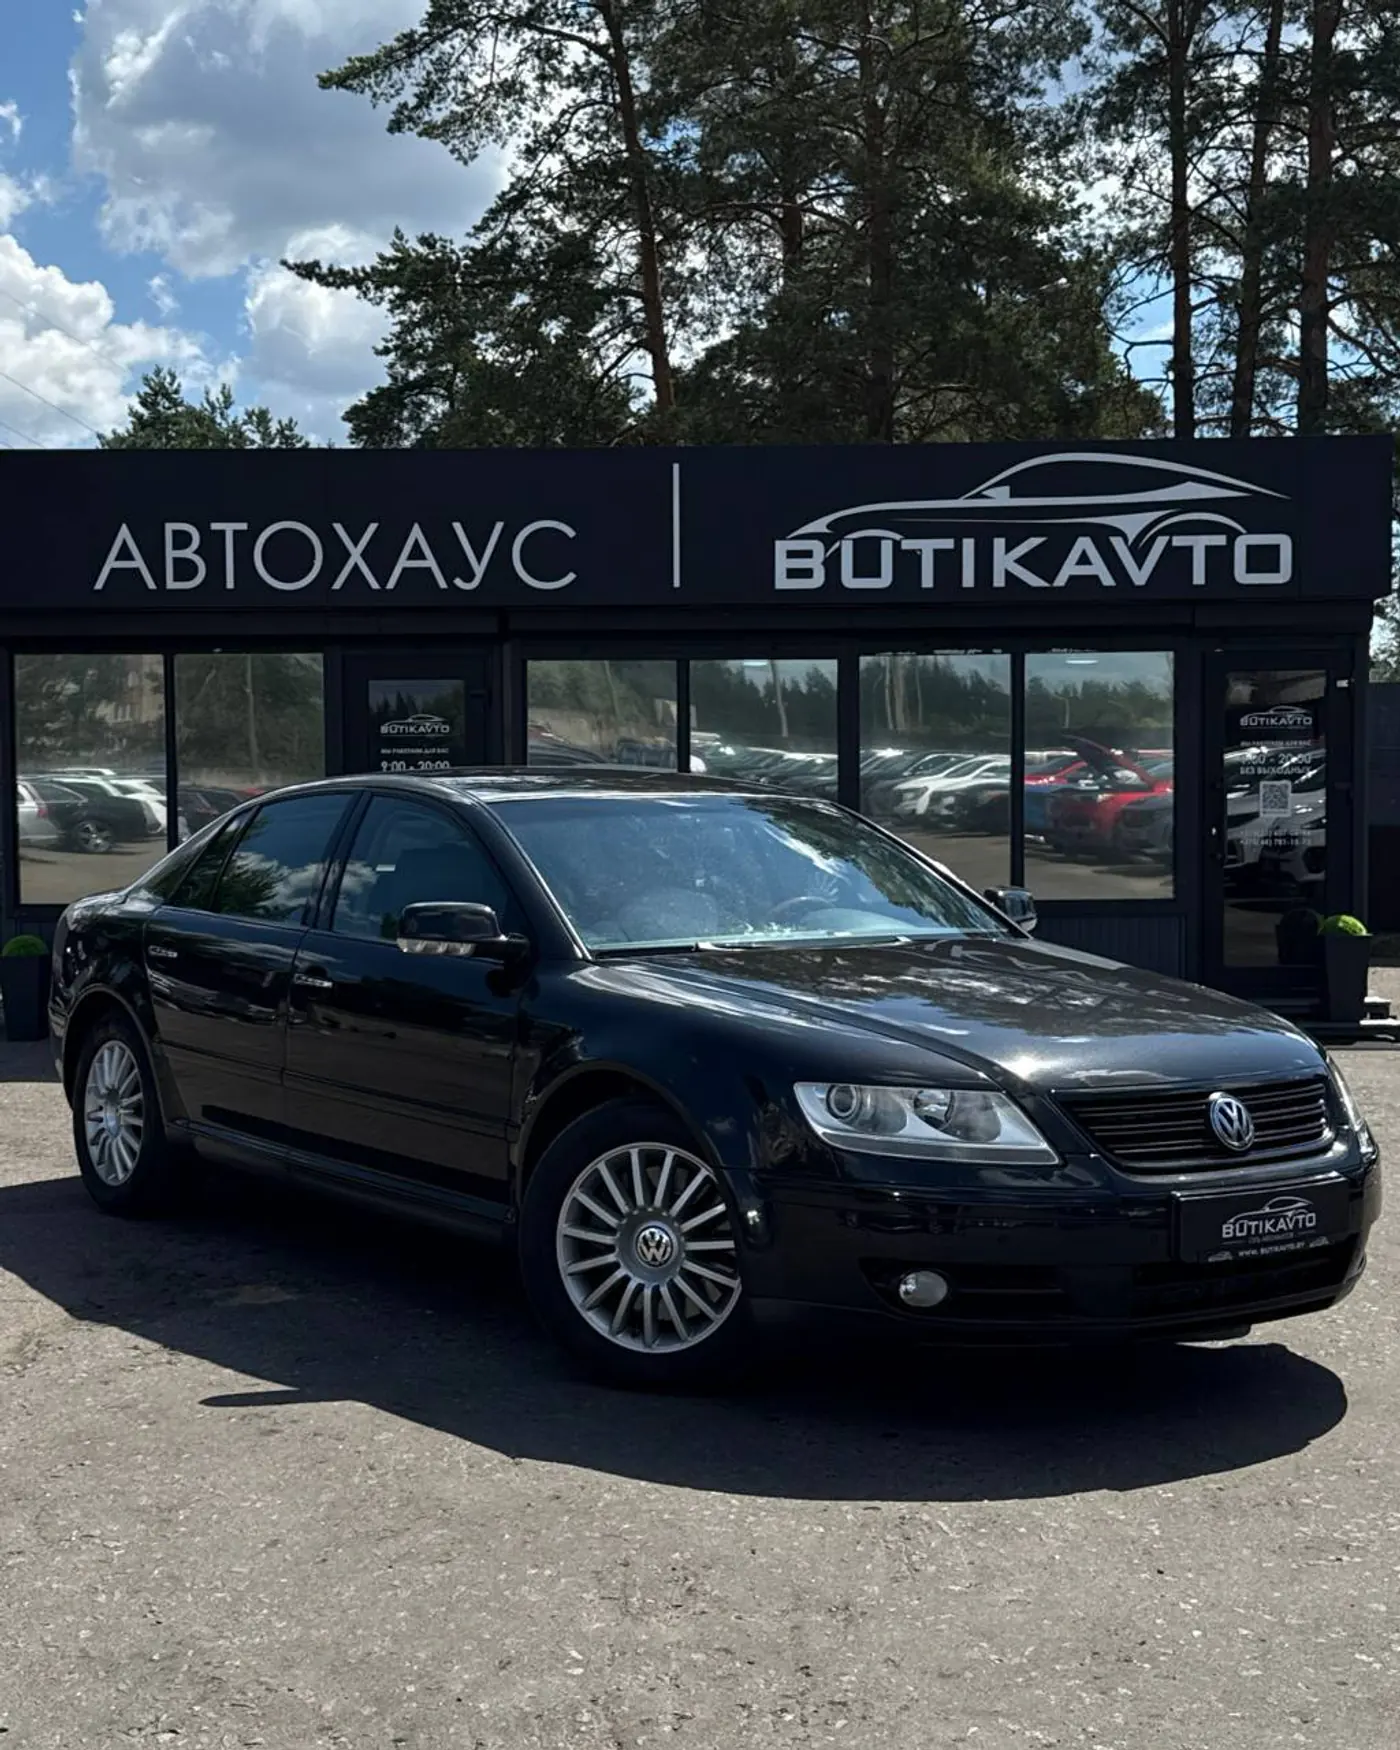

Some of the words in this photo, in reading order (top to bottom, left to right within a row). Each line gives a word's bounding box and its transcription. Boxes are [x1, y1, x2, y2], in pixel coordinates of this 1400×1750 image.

[94, 520, 578, 590] АВТОХАУС
[774, 533, 1293, 590] BUTIKAVTO
[380, 724, 450, 734] BUTIKAVTO
[1239, 716, 1313, 726] BUTIKAVTO
[1222, 1212, 1316, 1238] BUTIKAVTO
